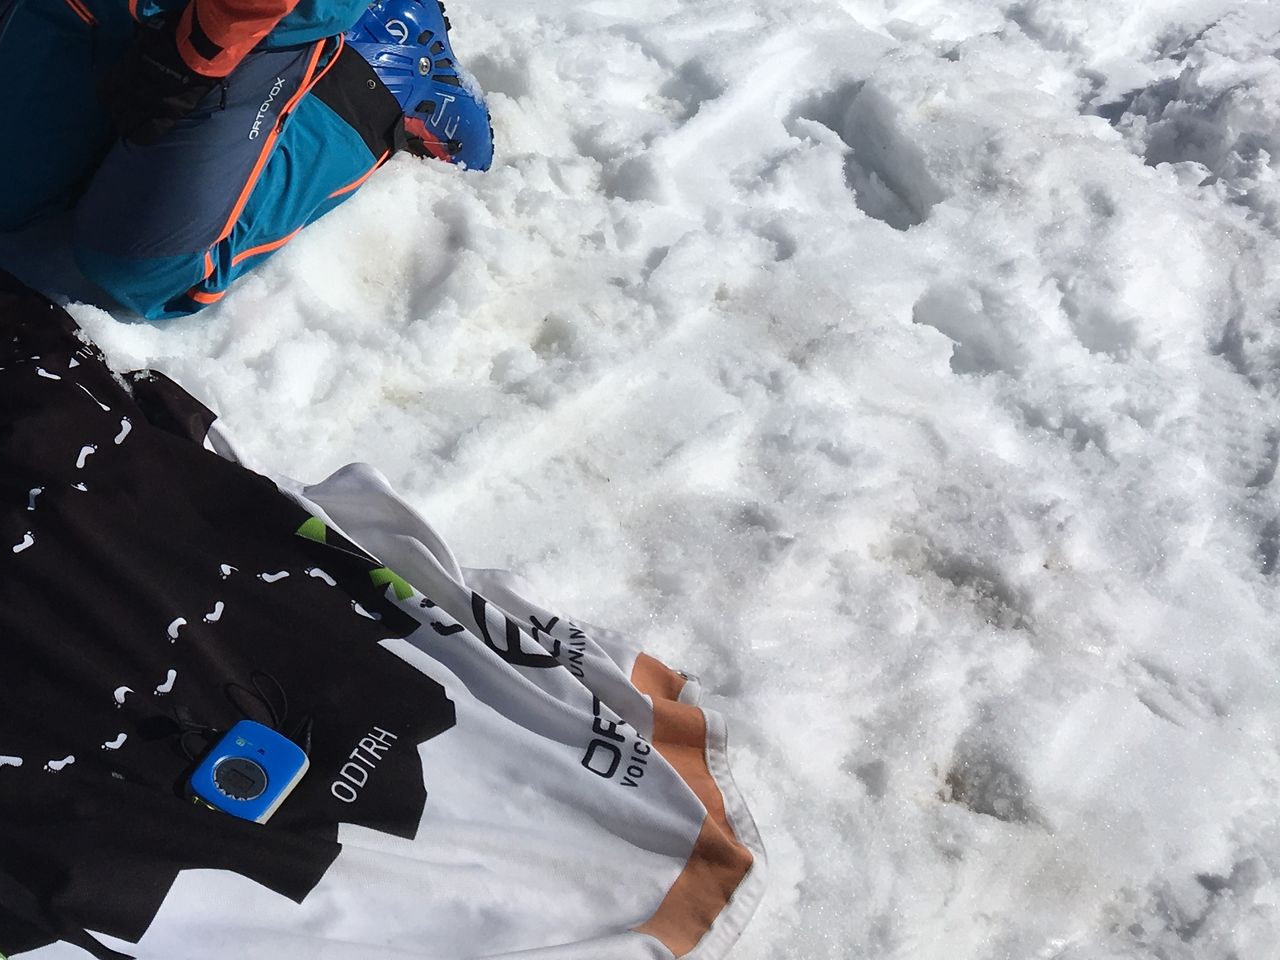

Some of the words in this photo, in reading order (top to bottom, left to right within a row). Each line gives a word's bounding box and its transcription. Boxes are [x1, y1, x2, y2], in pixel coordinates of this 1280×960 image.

[248, 77, 286, 140] ORTOVOX
[330, 726, 398, 803] ODTRH
[620, 732, 652, 788] VOIC
